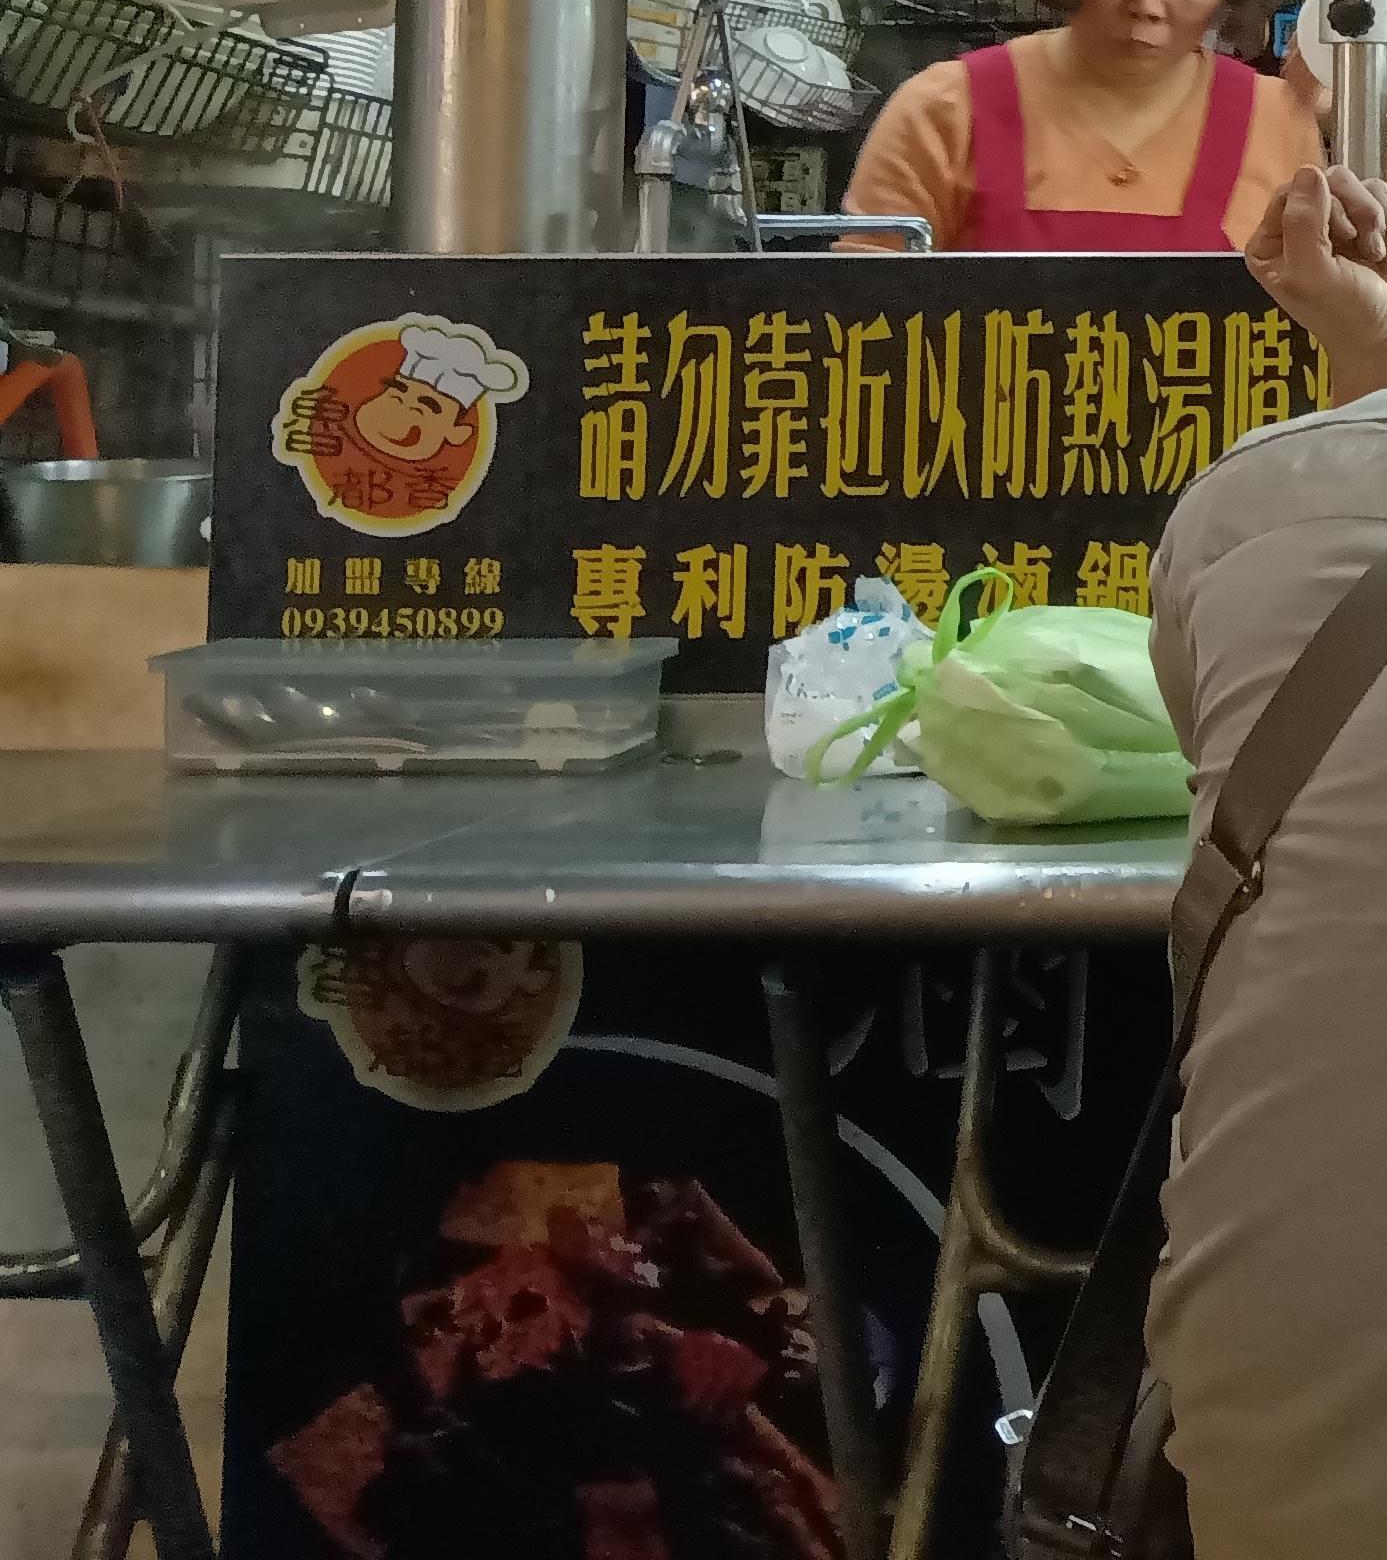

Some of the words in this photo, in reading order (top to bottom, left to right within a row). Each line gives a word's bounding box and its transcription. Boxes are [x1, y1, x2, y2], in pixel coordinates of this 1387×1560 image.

[578, 309, 1332, 500] 請勿靠近以防熱湯噴
[285, 558, 502, 595] 加盟專線
[281, 606, 504, 641] 0939450899
